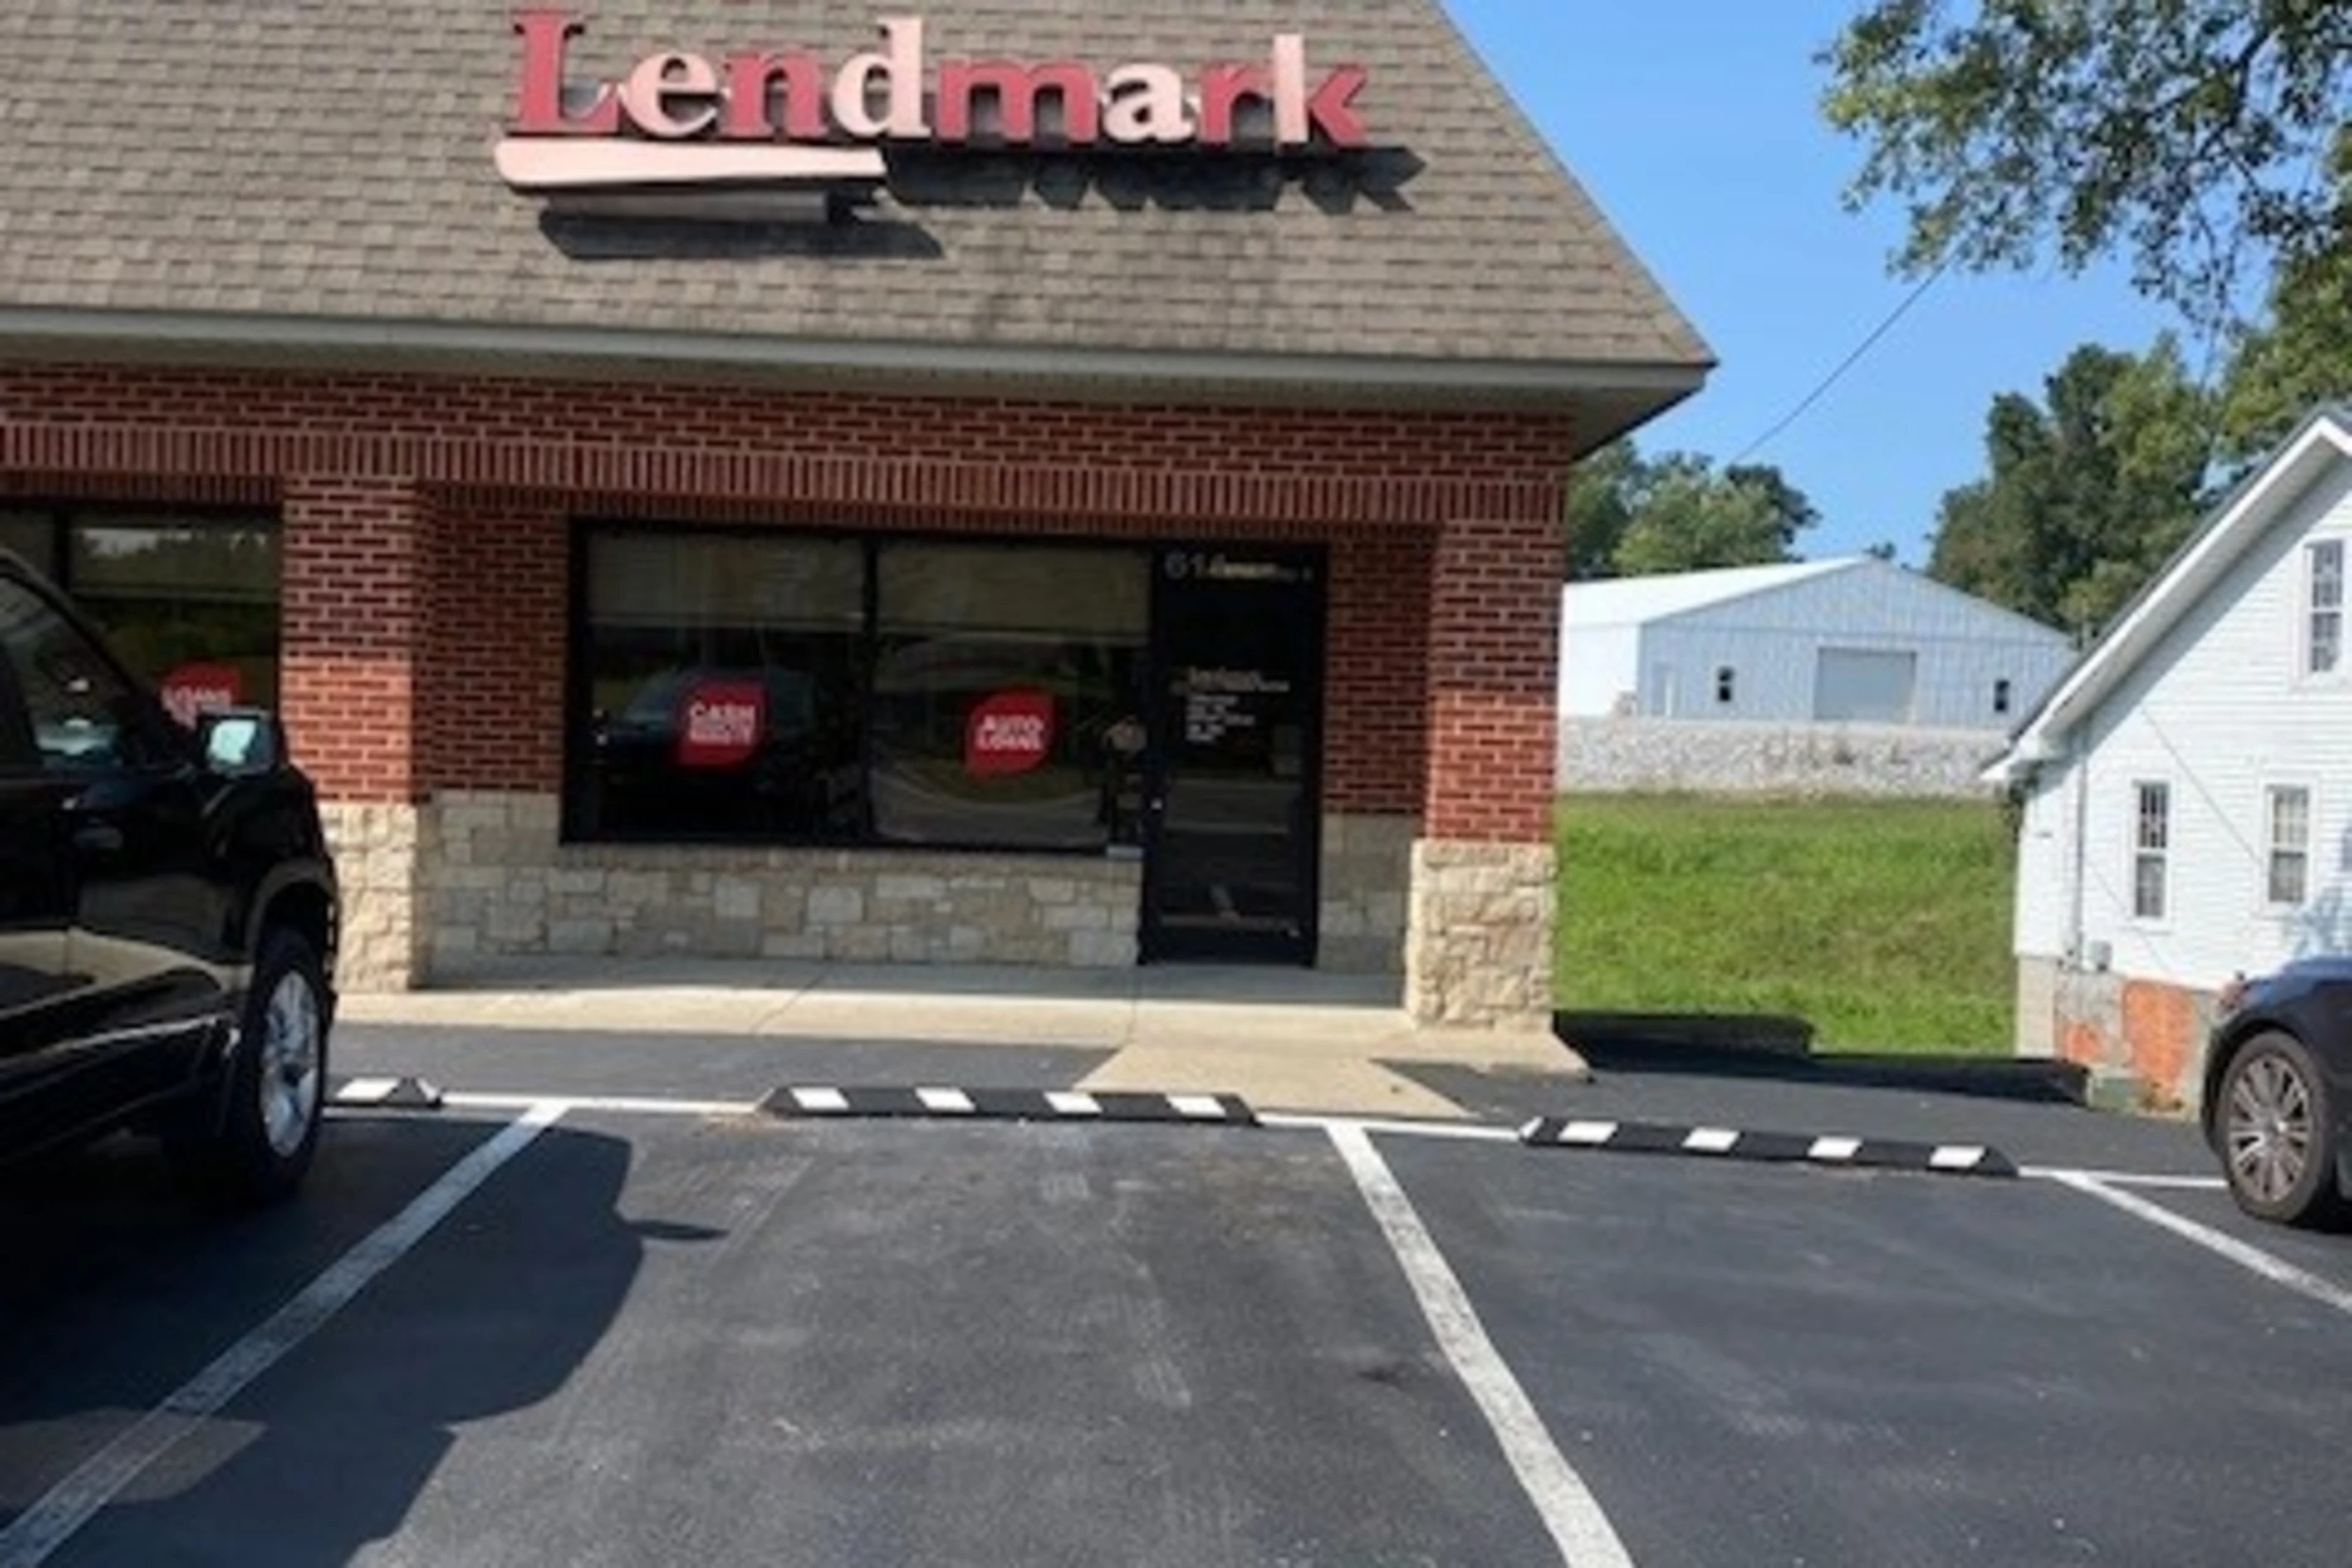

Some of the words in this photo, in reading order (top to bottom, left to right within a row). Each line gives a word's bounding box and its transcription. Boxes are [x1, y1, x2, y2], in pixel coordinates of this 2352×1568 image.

[514, 10, 1369, 147] Lendmark
[690, 701, 755, 725] CASH
[981, 714, 1044, 733] AUTO
